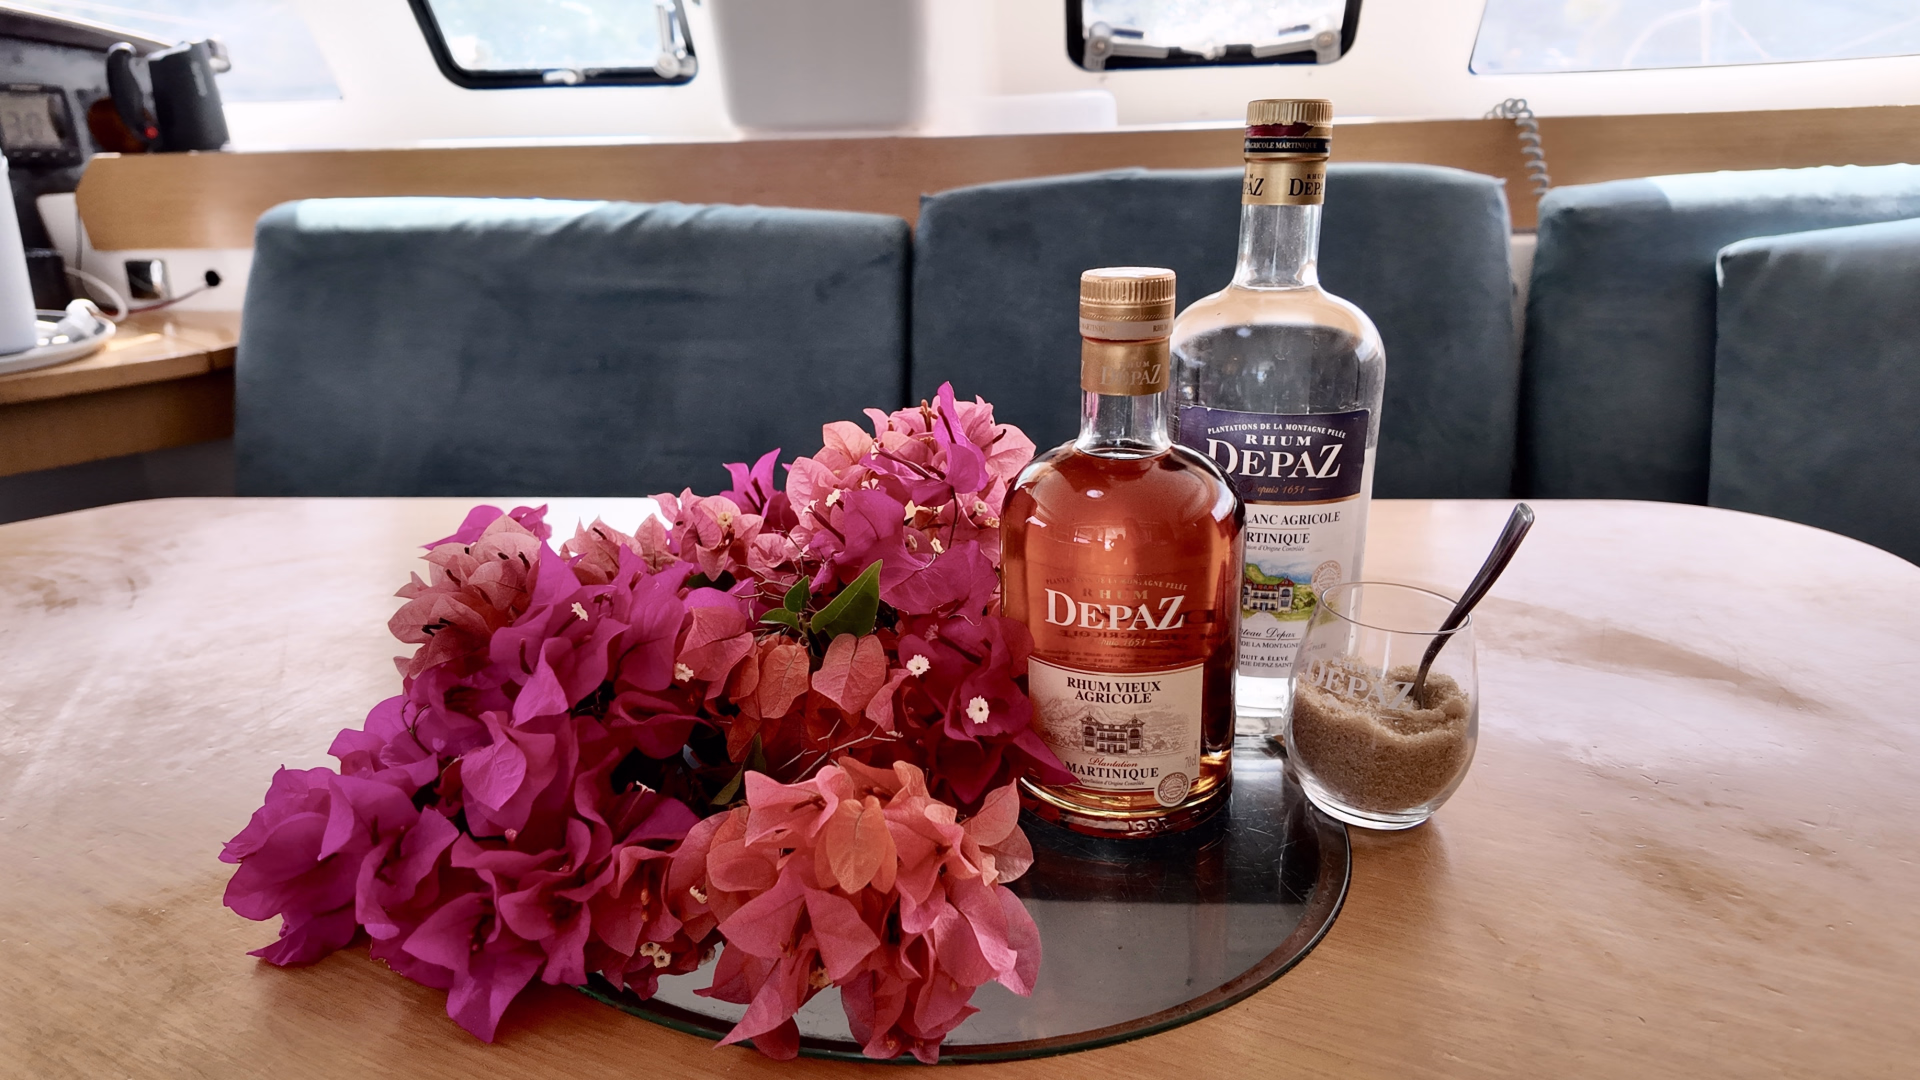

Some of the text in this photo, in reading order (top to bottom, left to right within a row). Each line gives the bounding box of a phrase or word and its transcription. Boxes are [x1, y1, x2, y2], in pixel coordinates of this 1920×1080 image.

[1243, 178, 1264, 196] PAZ
[1207, 423, 1258, 435] PLANTATIONS
[1285, 424, 1325, 434] MONTAGNE
[1327, 429, 1346, 439] PELÉE
[1245, 434, 1311, 446] RHUM
[1206, 438, 1343, 479] DEPAZ
[1282, 484, 1305, 494] 1651
[1280, 511, 1341, 526] AGRICOLE
[1246, 531, 1310, 546] RTINIQUE
[1258, 544, 1281, 553] d'Origine
[1083, 588, 1148, 600] RHUM
[1165, 582, 1188, 591] PELÉE
[1045, 588, 1185, 631] DEPAZ
[1265, 627, 1296, 641] Depaz
[1067, 677, 1161, 693] RHUM VIEUX
[1305, 653, 1415, 711] DEPAZ
[1075, 690, 1152, 704] AGRICOLE
[1088, 757, 1138, 768] Plantation
[1065, 761, 1159, 780] MARTINIQUE
